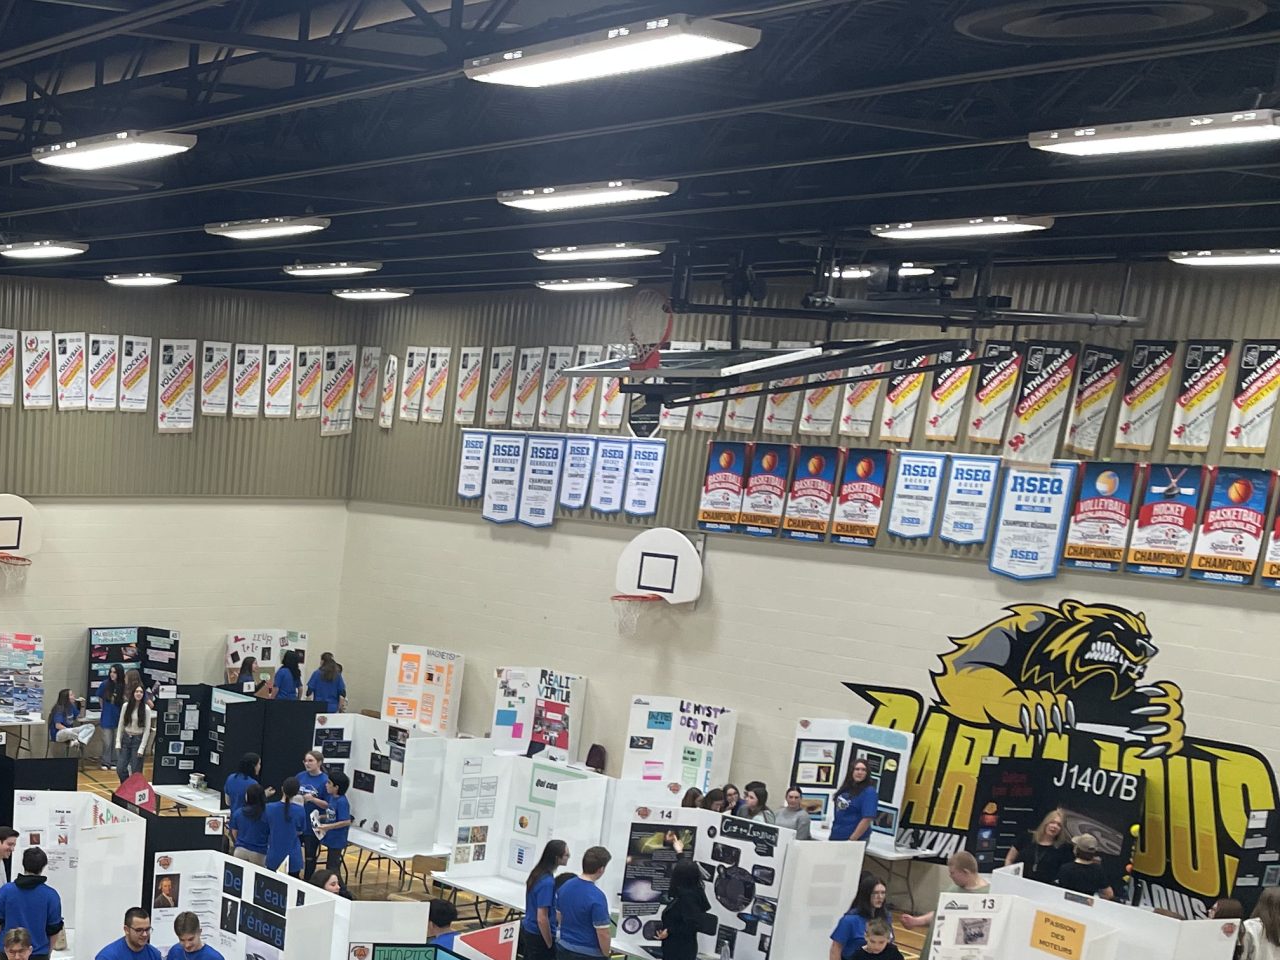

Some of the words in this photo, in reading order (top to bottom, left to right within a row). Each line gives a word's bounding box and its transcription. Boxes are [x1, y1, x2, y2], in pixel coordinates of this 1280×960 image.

[122, 348, 147, 376] HOCKEY
[1184, 349, 1226, 388] HOCKEY
[160, 352, 193, 388] VOLLEYBALL
[1018, 365, 1071, 414] CHAMPIONS
[1180, 363, 1226, 405] CHAMPIONS
[492, 444, 521, 457] RSEQ
[530, 446, 559, 460] RSEQ
[902, 463, 937, 478] RSEQ
[953, 467, 992, 482] RSEQ
[1010, 475, 1064, 495] RSEQ
[1079, 499, 1127, 515] VOLLEYBALL
[1152, 503, 1187, 517] HOCKEY
[702, 511, 737, 521] CHAMPIONS
[1151, 516, 1185, 526] CADETS
[1208, 508, 1262, 527] BASKETBALL
[787, 518, 825, 531] CHAMPIONS
[836, 524, 875, 536] CHAMPIONS
[1010, 548, 1039, 560] RSEQ
[1067, 546, 1123, 560] CHAMPIONNES
[1133, 550, 1186, 566] CHAMPIONS
[1198, 556, 1253, 573] CHAMPIONS
[539, 669, 571, 688] RÉALI
[679, 700, 692, 713] LE
[680, 715, 699, 730] DES
[1053, 762, 1138, 801] J1407B
[138, 793, 146, 801] 20
[659, 810, 673, 820] 14
[224, 869, 241, 891] De
[981, 898, 995, 910] 13
[1044, 917, 1077, 934] PASSION
[503, 927, 515, 940] 22
[1050, 931, 1066, 941] DES
[1038, 939, 1073, 956] MOTEURS
